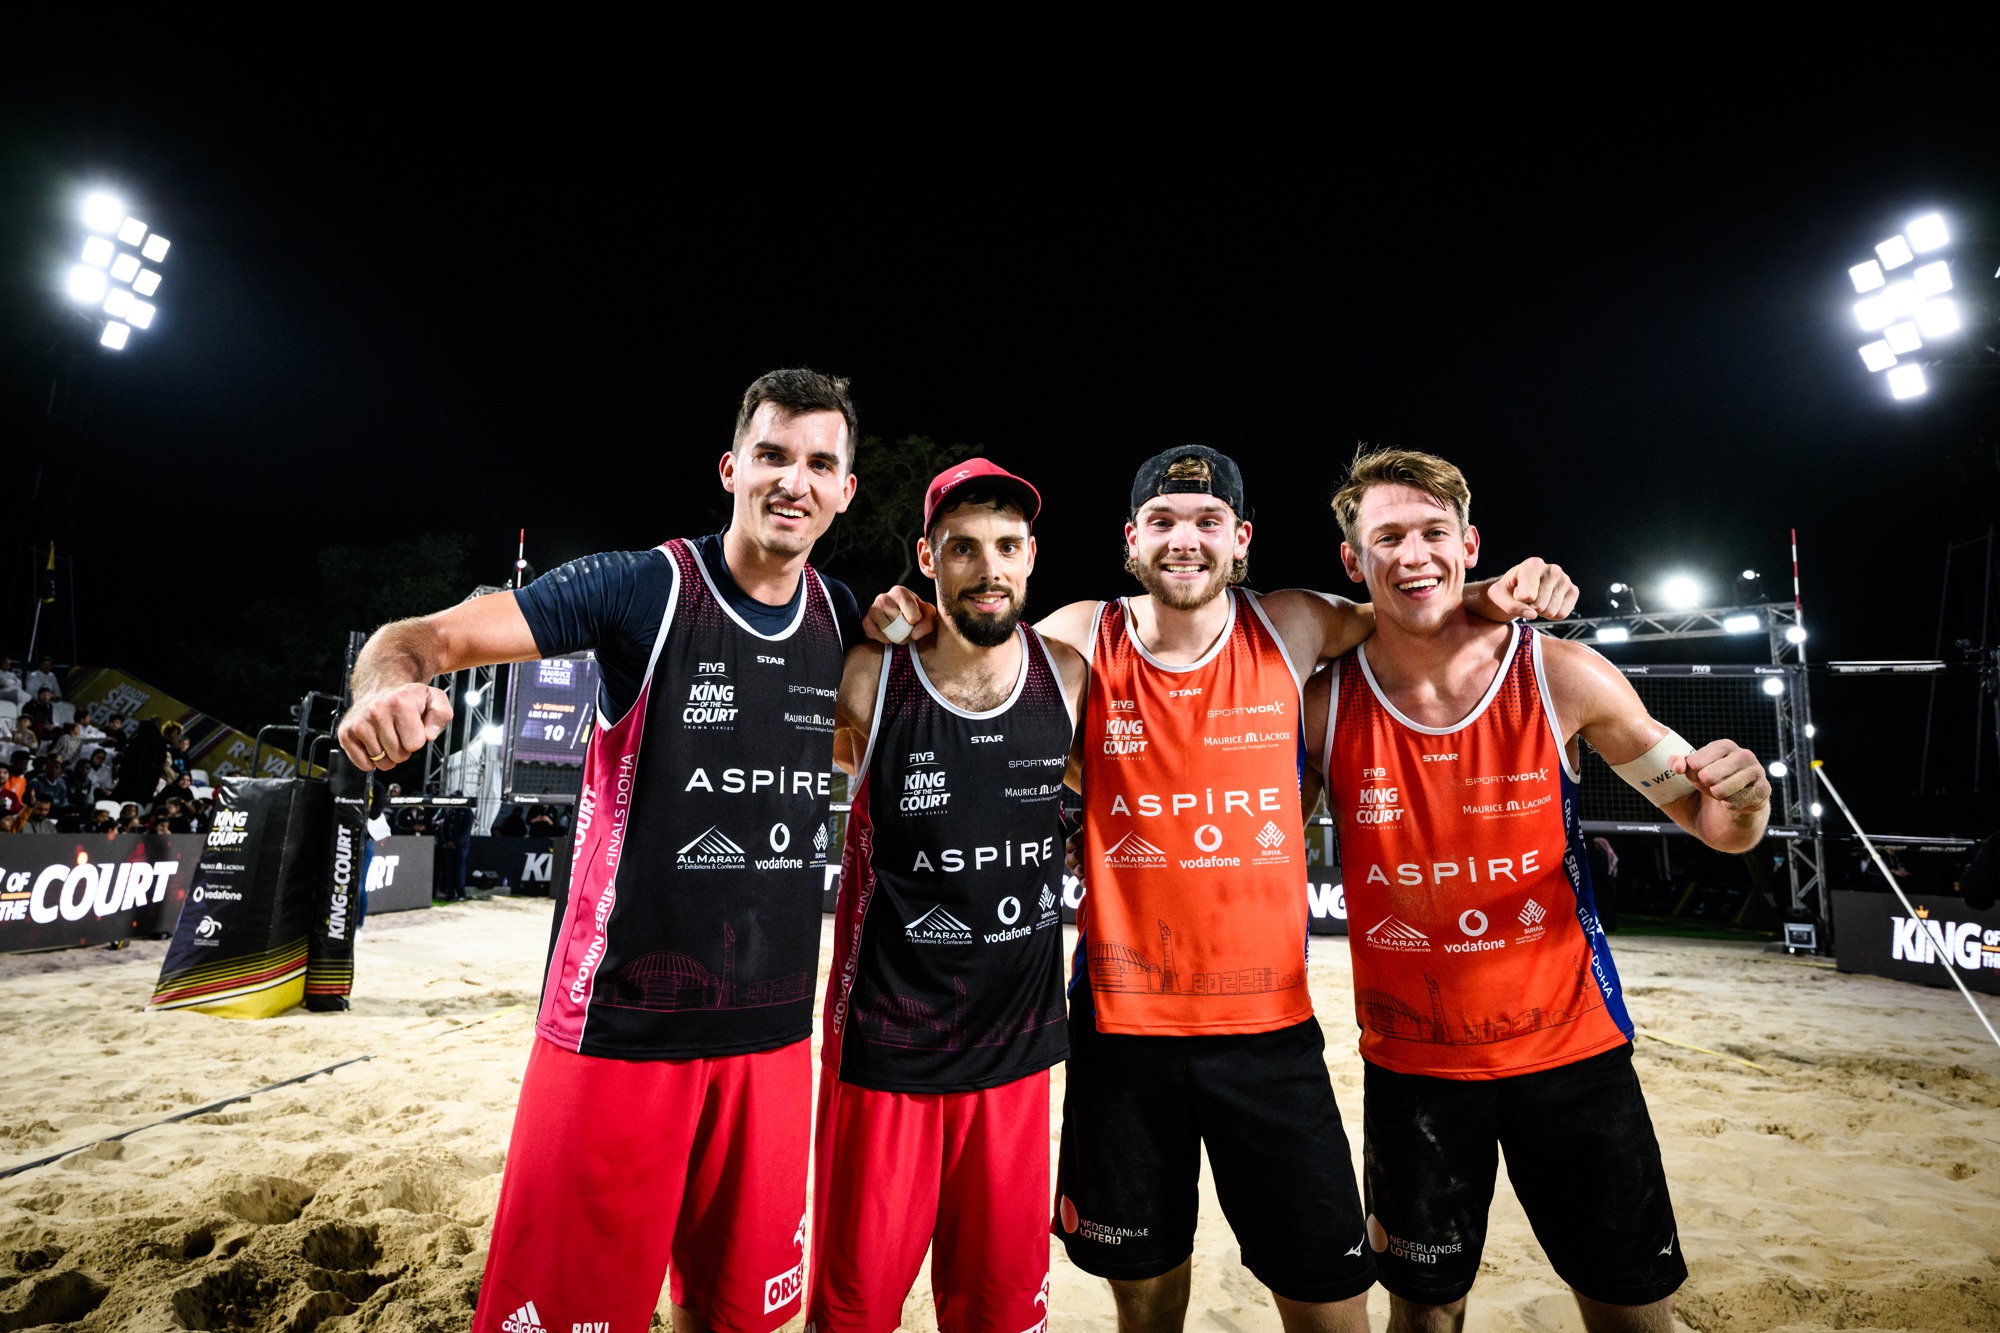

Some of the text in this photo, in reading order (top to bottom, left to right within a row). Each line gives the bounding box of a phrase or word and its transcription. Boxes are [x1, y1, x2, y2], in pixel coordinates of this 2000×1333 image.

[699, 662, 725, 673] FIVB
[757, 655, 785, 665] STAR
[689, 683, 734, 701] KING
[1168, 687, 1203, 697] STAR
[683, 708, 738, 723] COURT
[784, 712, 812, 723] MAURICE
[1207, 700, 1285, 718] SPORTWORX
[544, 724, 565, 741] 10
[1106, 717, 1143, 735] KING
[971, 734, 1004, 744] STAR
[1103, 740, 1148, 755] COURT
[1204, 735, 1242, 747] MAURICE
[1259, 732, 1290, 742] LACROIX
[227, 740, 296, 779] RYAL
[909, 751, 935, 763] FIVB
[1422, 753, 1459, 762] STAR
[904, 771, 946, 791] KING
[1363, 767, 1386, 778] FIVB
[1465, 768, 1549, 786] SPORTWORX
[685, 766, 831, 800] ASPIRE
[1005, 788, 1038, 797] MAURICE
[1360, 785, 1398, 804] KING
[606, 753, 635, 867] FINALS DOHA
[900, 793, 951, 812] COURT
[1110, 787, 1281, 817] ASPIRE
[1463, 804, 1504, 815] MAURICE
[1521, 795, 1552, 810] LACROIX
[213, 810, 248, 827] KING
[1356, 808, 1404, 824] COURT
[207, 831, 248, 846] COURT
[334, 824, 352, 885] COURT
[755, 856, 803, 870] vodafone
[913, 836, 1053, 873] ASPIRE
[1179, 855, 1240, 869] vodafone
[1366, 849, 1540, 886] ASPIRE
[6, 871, 32, 892] OF
[29, 860, 179, 924] COURT
[205, 890, 242, 901] vodafone
[0, 899, 30, 921] THE
[328, 893, 348, 940] KING
[984, 924, 1032, 944] vodafone
[1524, 925, 1544, 934] SUHAIL
[570, 877, 616, 1004] CROWN SERIE
[1444, 938, 1505, 953] vodafone
[1890, 916, 1982, 970] KING
[1981, 951, 2000, 969] TH
[1192, 968, 1254, 994] 2022
[1592, 954, 1613, 999] DOHA
[1080, 1218, 1148, 1237] NEDERLANDSE
[1080, 1227, 1121, 1245] LOTERIJ
[1389, 1234, 1462, 1254] NEDERLANDSE
[1390, 1244, 1436, 1264] LOTERIJ
[768, 1265, 803, 1306] ORLE
[501, 1319, 547, 1333] adidas
